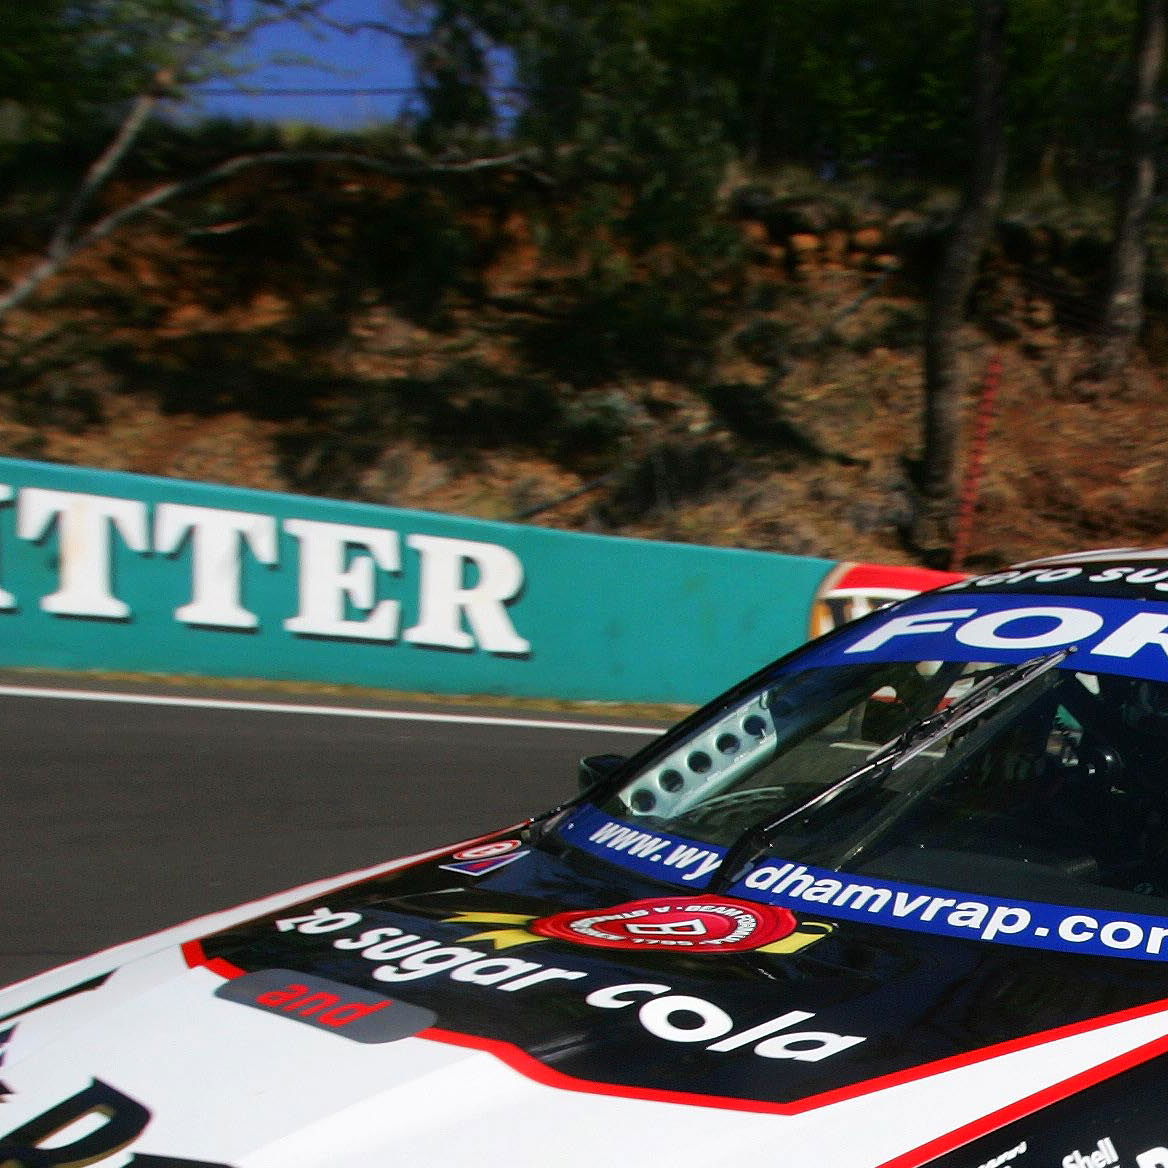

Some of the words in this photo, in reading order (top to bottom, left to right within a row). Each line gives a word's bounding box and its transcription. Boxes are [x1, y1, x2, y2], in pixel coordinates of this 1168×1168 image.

[0, 484, 530, 655] TTER
[256, 982, 394, 1028] and
[334, 926, 589, 992] sugar
[585, 983, 867, 1062] cola
